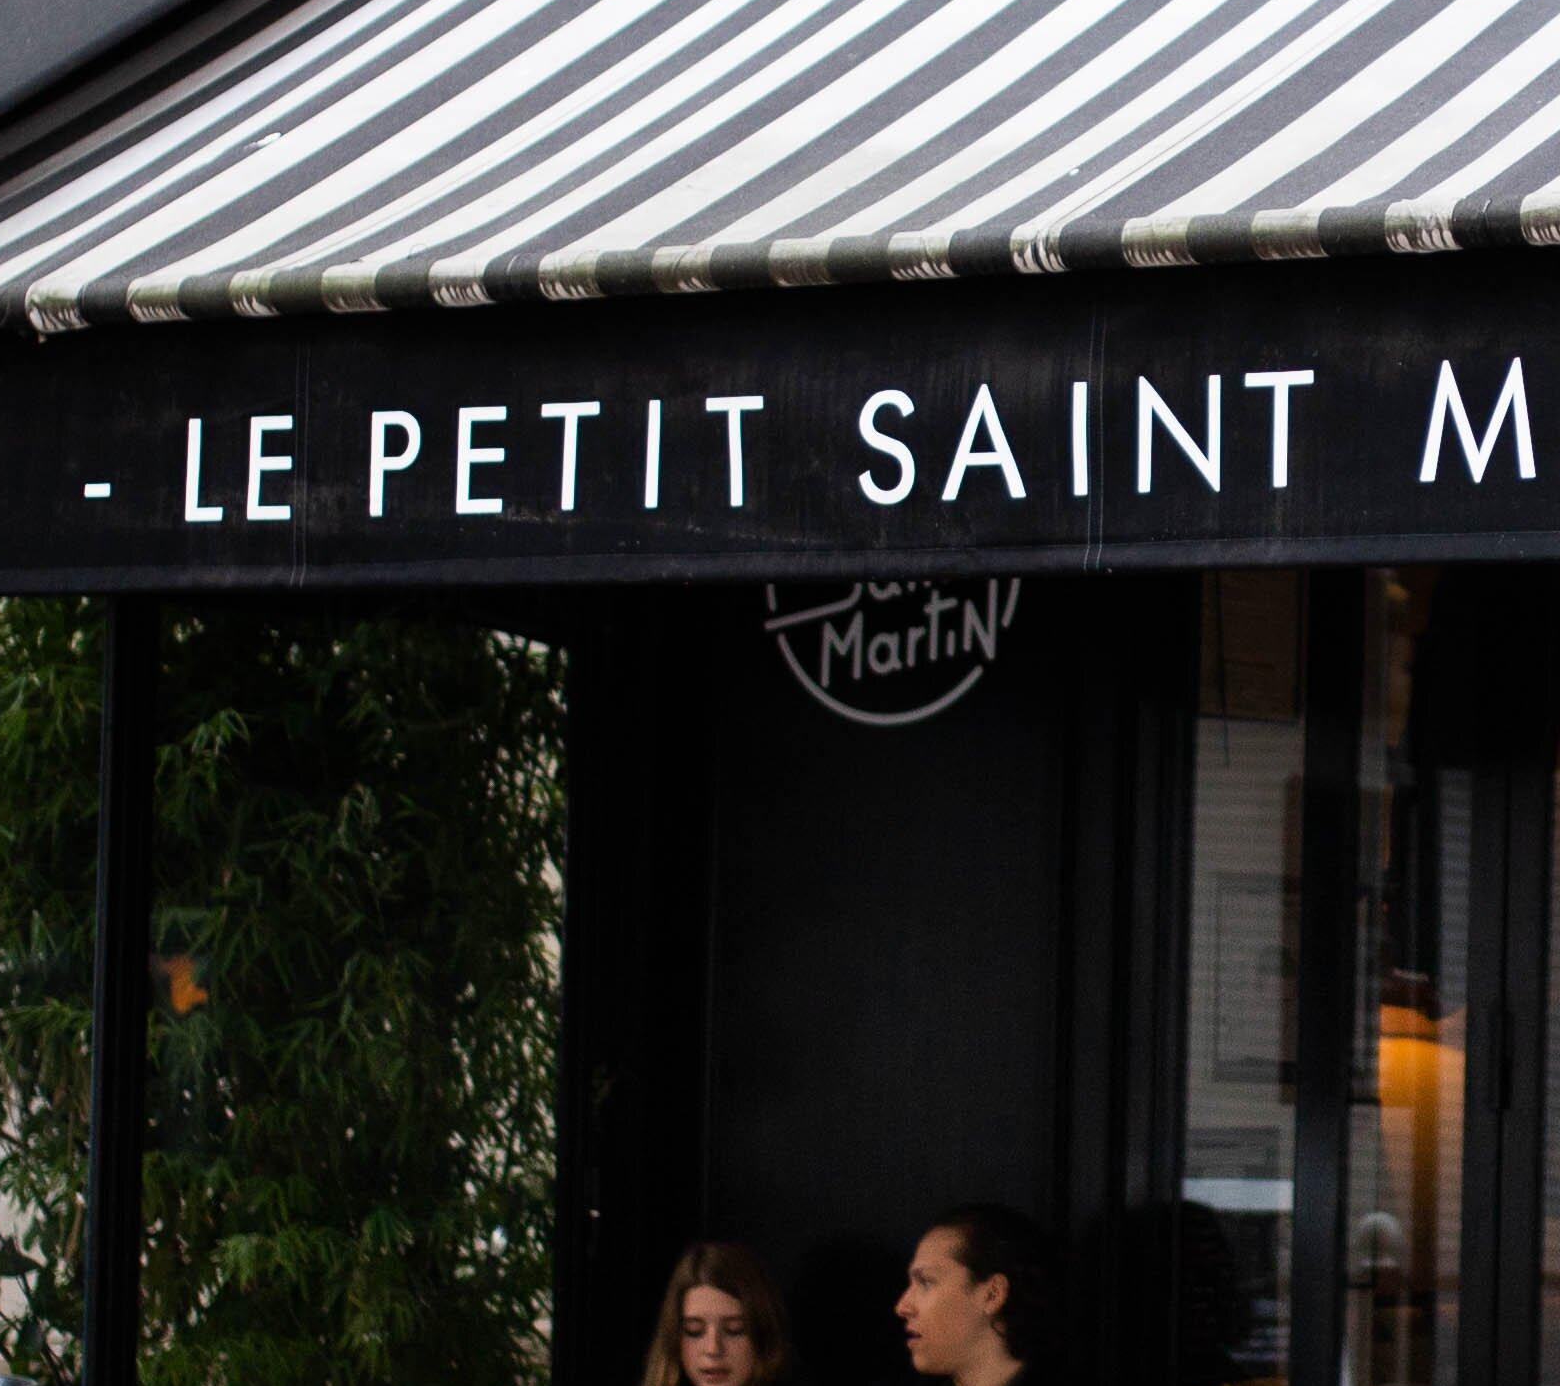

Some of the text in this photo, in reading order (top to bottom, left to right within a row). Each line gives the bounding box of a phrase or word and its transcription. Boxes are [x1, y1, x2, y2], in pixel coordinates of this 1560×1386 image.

[183, 413, 294, 524] LE
[367, 394, 765, 519] PETIT
[857, 368, 1316, 506] SAINT
